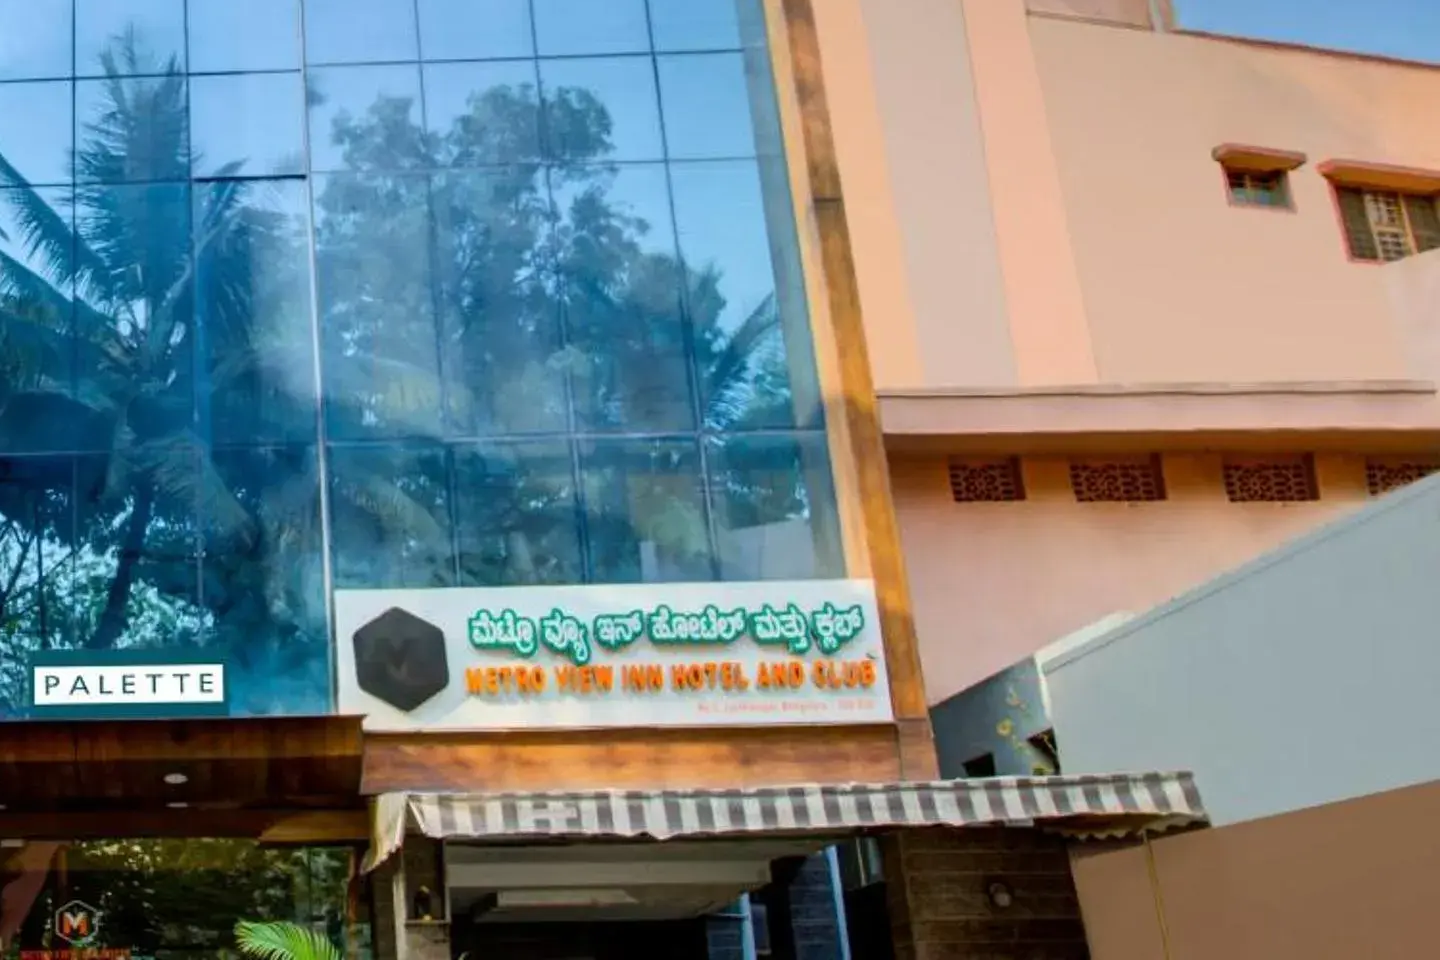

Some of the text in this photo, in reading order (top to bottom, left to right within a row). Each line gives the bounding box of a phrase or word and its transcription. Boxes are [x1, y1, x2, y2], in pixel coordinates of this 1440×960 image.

[594, 610, 644, 650] ಇನ್
[648, 604, 746, 644] ಹೋಟೆಲ್
[750, 603, 810, 653] ಮತ್ತು
[812, 602, 864, 654] ಕ್ಲಬ್
[44, 672, 214, 696] PALETTE
[465, 658, 876, 694] METRO VIEW INN HOTEL AND CLUB
[62, 911, 89, 937] M
